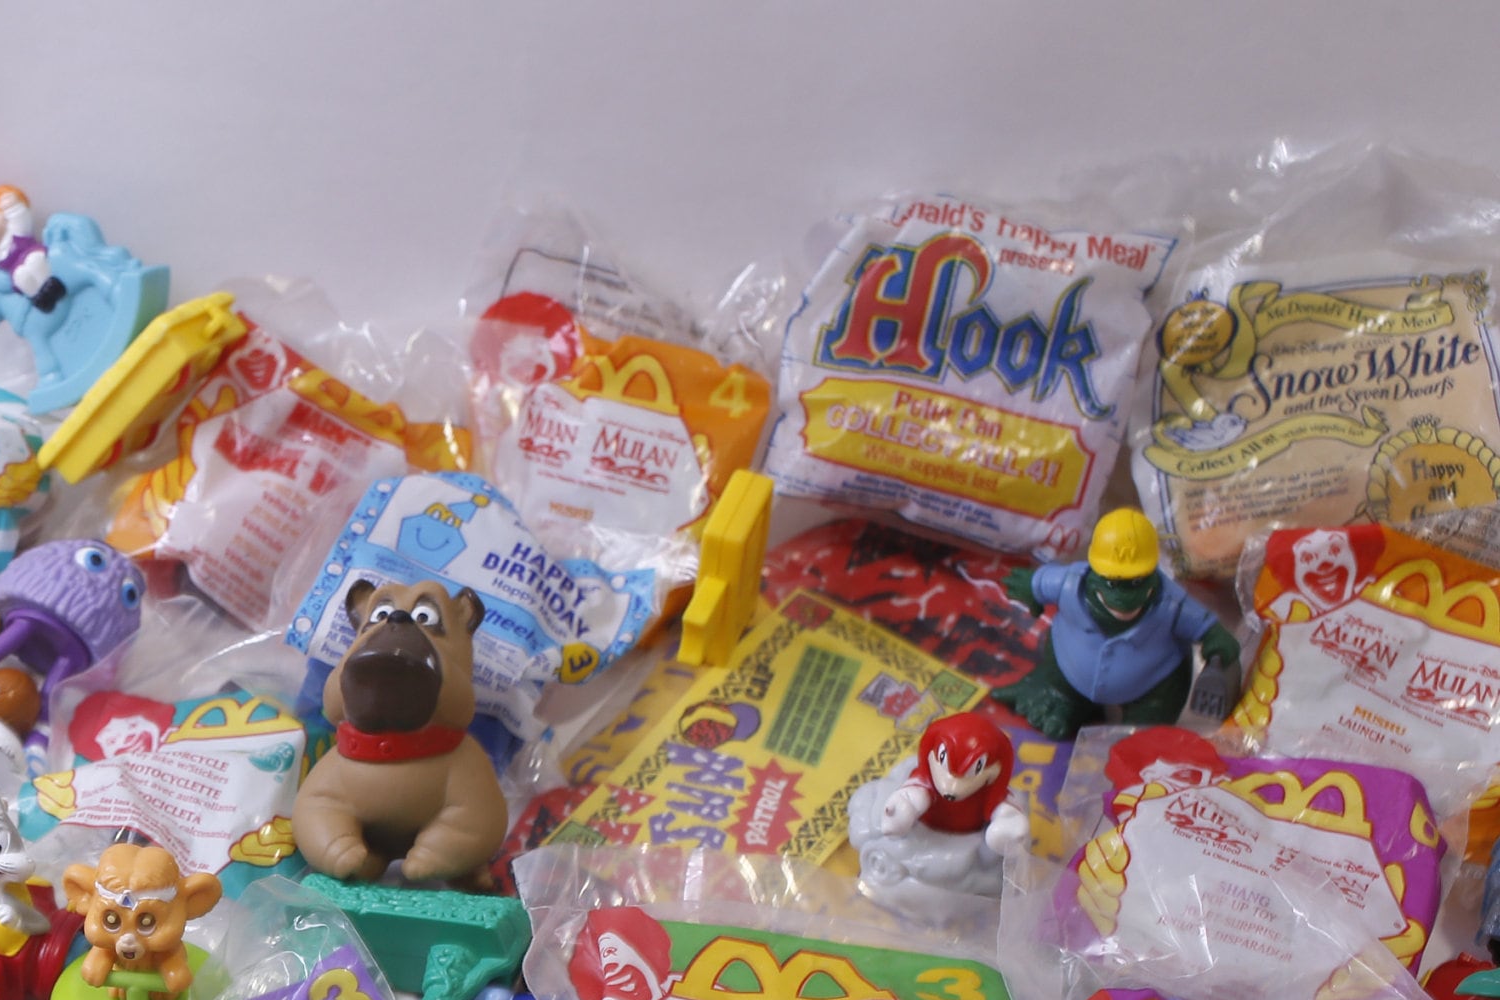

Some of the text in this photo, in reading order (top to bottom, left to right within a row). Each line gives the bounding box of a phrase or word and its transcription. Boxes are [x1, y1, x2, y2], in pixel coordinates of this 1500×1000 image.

[1087, 236, 1150, 271] Meal
[814, 234, 1116, 420] Hook
[709, 371, 750, 419] 4
[1226, 334, 1480, 421] Snow White
[959, 408, 1003, 439] Pan
[1284, 400, 1314, 415] and
[828, 405, 1063, 487] COLLECT ALL 4!
[482, 552, 590, 638] BIRTHDAY
[511, 542, 585, 608] HAPPY
[1338, 715, 1386, 746] LAUNCH
[123, 761, 222, 800] MOTOCYCLETTE
[744, 777, 786, 847] PATROL
